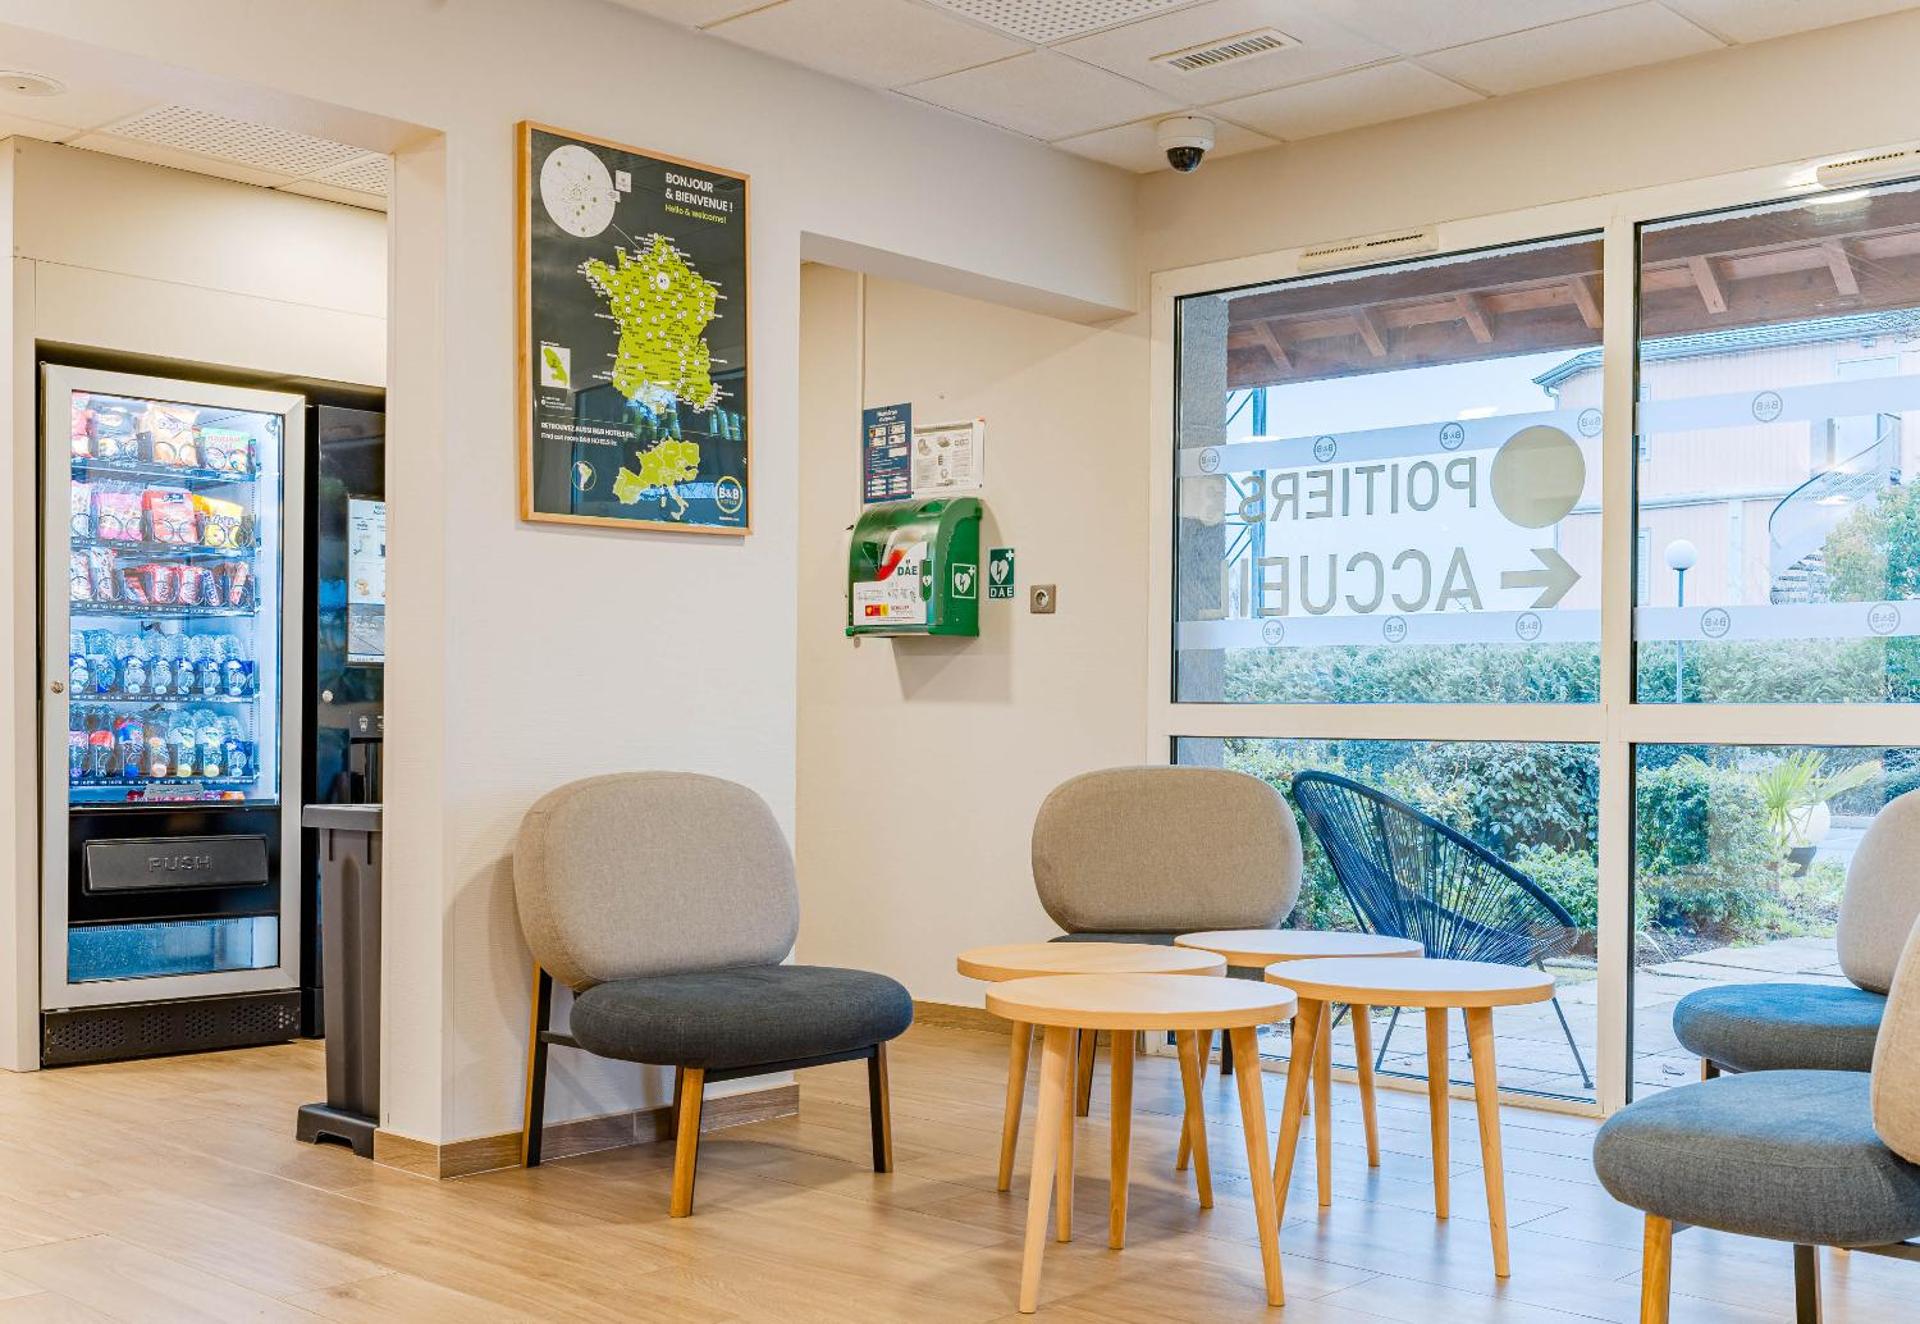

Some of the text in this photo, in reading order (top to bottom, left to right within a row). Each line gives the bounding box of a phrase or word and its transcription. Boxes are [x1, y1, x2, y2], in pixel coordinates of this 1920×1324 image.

[666, 172, 713, 193] BONJOUR
[665, 188, 674, 200] &
[675, 190, 728, 211] BIENVENUE
[665, 204, 727, 224] Hello & welcome!
[541, 422, 574, 432] RETROUVEZ
[719, 487, 739, 500] B&B
[897, 565, 918, 576] DAE
[990, 586, 1013, 598] DAE
[148, 855, 213, 873] PUSH
